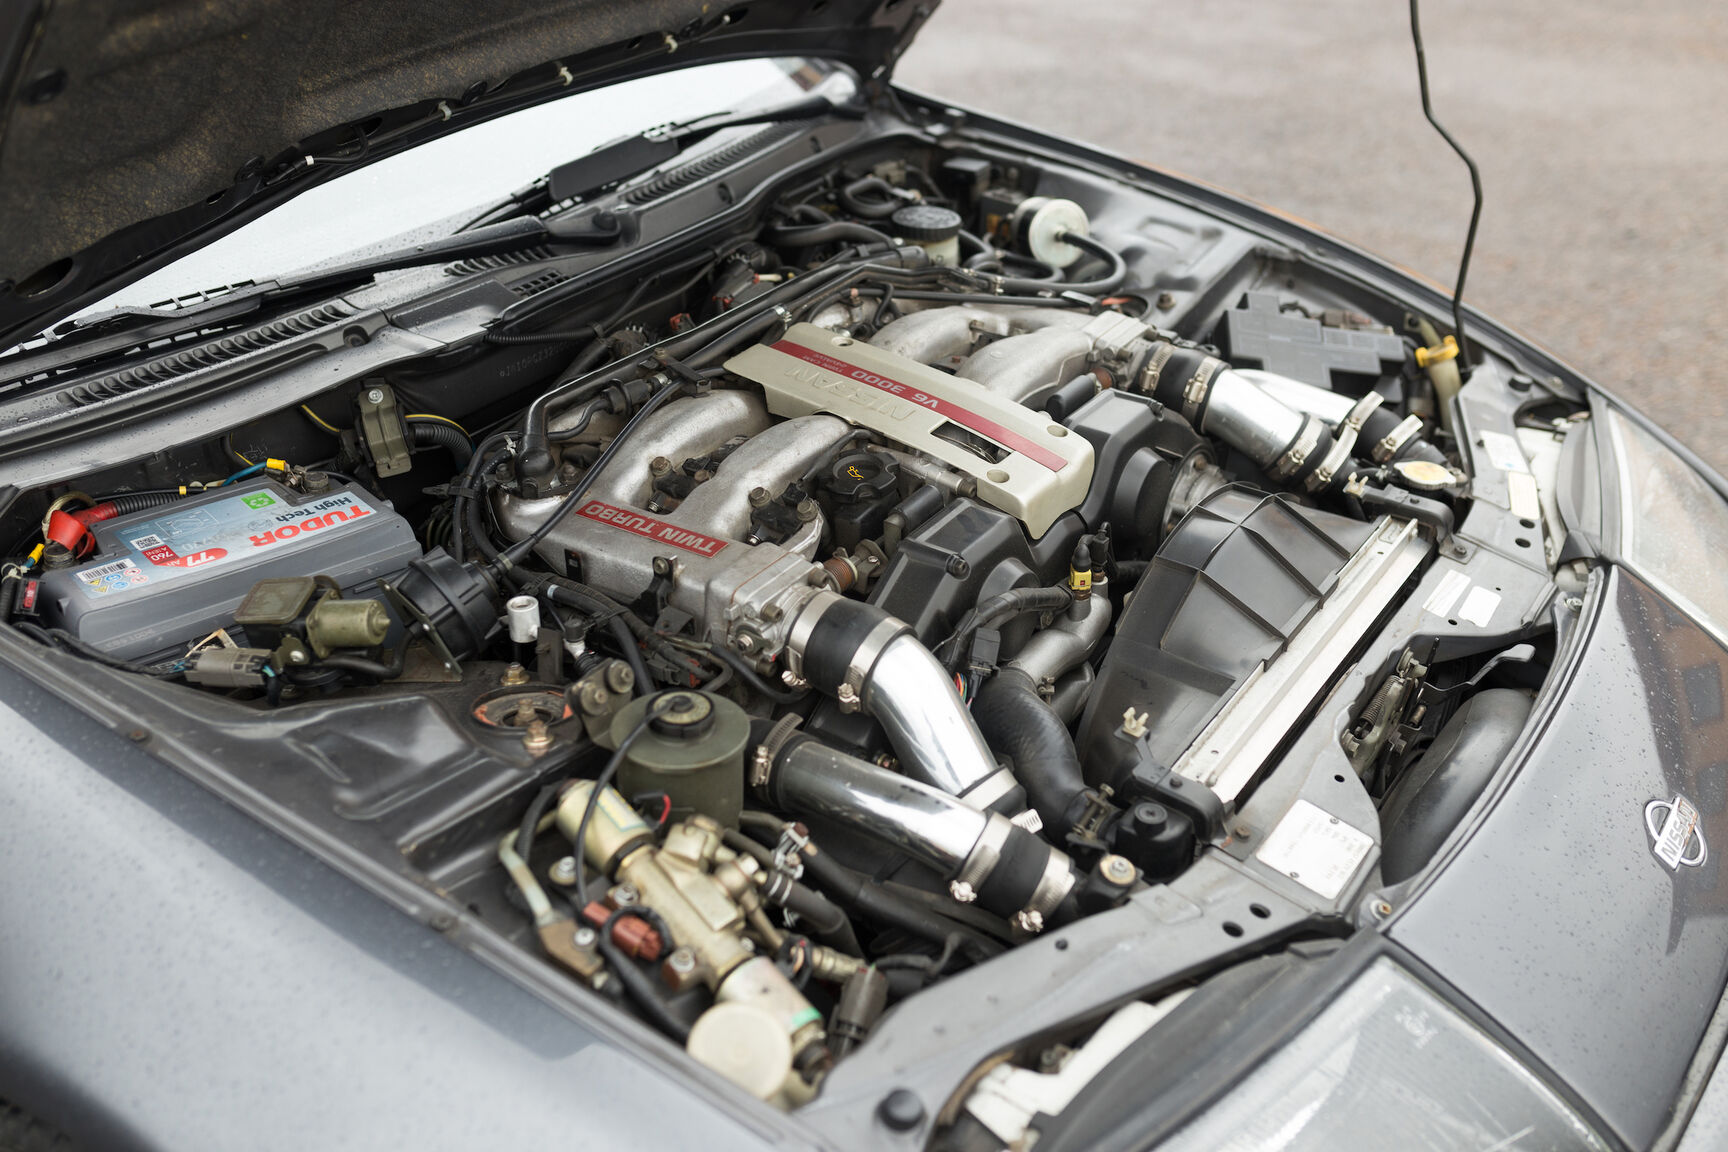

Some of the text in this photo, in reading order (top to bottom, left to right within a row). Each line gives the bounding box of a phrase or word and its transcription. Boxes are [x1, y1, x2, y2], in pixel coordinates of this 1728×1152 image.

[784, 365, 916, 421] NISSAN
[851, 370, 939, 409] V6 3000
[248, 505, 371, 547] TUDOR
[276, 497, 353, 522] High Tech
[585, 504, 715, 553] TWIN TURBO
[150, 551, 174, 561] 760
[187, 552, 216, 567] 77
[1661, 800, 1697, 861] NISSAN
